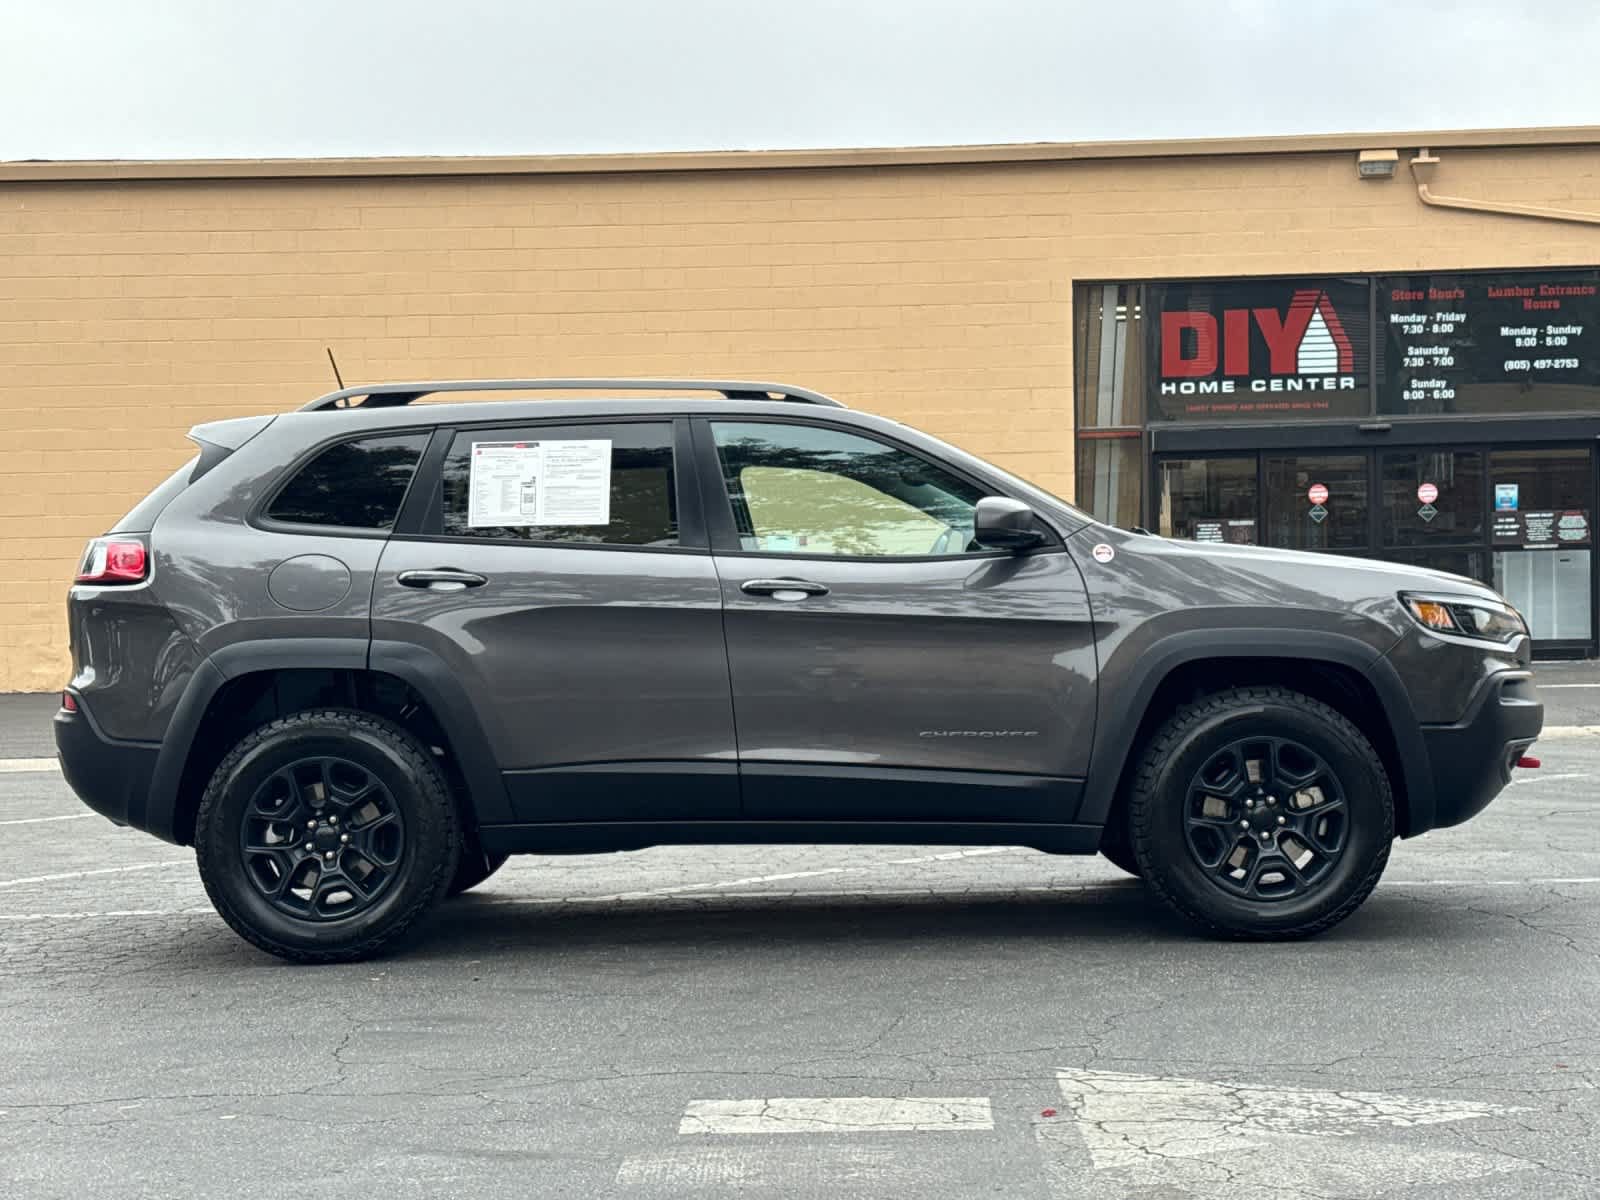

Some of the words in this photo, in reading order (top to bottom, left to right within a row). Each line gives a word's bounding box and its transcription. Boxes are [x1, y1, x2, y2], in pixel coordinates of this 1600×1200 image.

[1391, 289, 1425, 301] Store
[1487, 286, 1536, 298] Lumber
[1539, 284, 1597, 296] Entrance
[1523, 299, 1561, 310] Hours
[1390, 313, 1427, 324] Monday
[1436, 312, 1467, 323] Friday
[1160, 289, 1321, 378] DIY
[1402, 324, 1424, 335] 7:30
[1432, 323, 1454, 334] 8:00
[1500, 326, 1538, 337] Monday
[1546, 324, 1584, 336] Sunday
[1545, 336, 1568, 347] 5:00
[1407, 345, 1450, 356] Saturday
[1403, 357, 1425, 367] 7:30
[1433, 356, 1454, 367] 7:00
[1504, 360, 1531, 372] (805)
[1161, 380, 1236, 395] HOME
[1251, 377, 1356, 393] CENTER
[1411, 378, 1447, 389] Sunday
[1432, 389, 1455, 400] 6:00
[919, 730, 1039, 739] CHEROKEE
